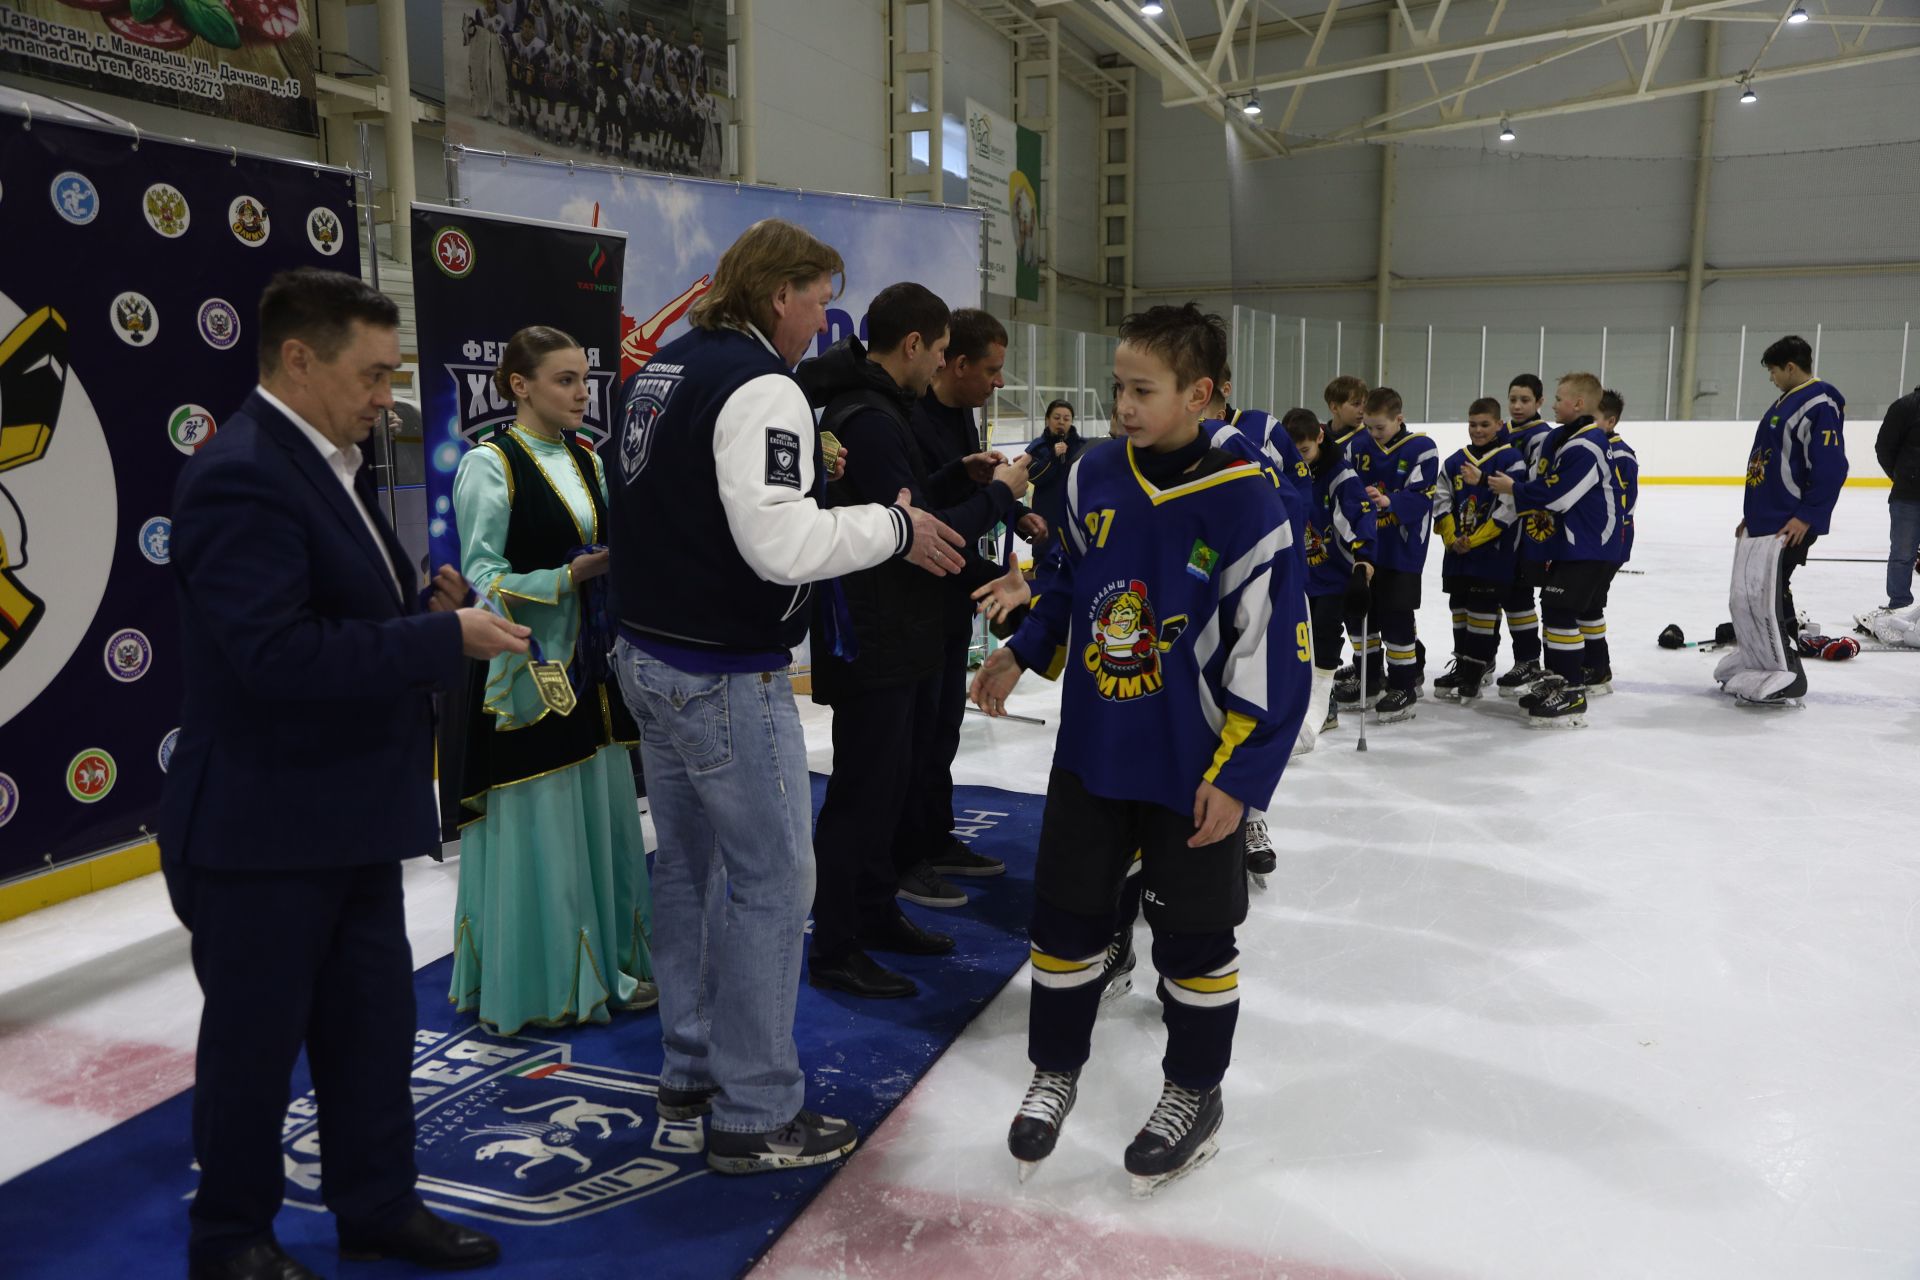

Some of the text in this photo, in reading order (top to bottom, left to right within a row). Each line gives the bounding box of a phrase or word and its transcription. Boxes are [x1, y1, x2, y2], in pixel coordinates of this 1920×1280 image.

[0, 7, 92, 47] Татарстан,
[96, 35, 107, 49] г.
[111, 35, 191, 71] Мамадыш,
[220, 64, 268, 88] Дачная
[0, 37, 223, 98] -mamad.ru. тел. 88556335273
[576, 281, 618, 293] TATNEFT
[1088, 579, 1126, 620] МАМАДЫШ
[1296, 621, 1313, 664] 9
[415, 1080, 502, 1139] ПУБЛИКИ
